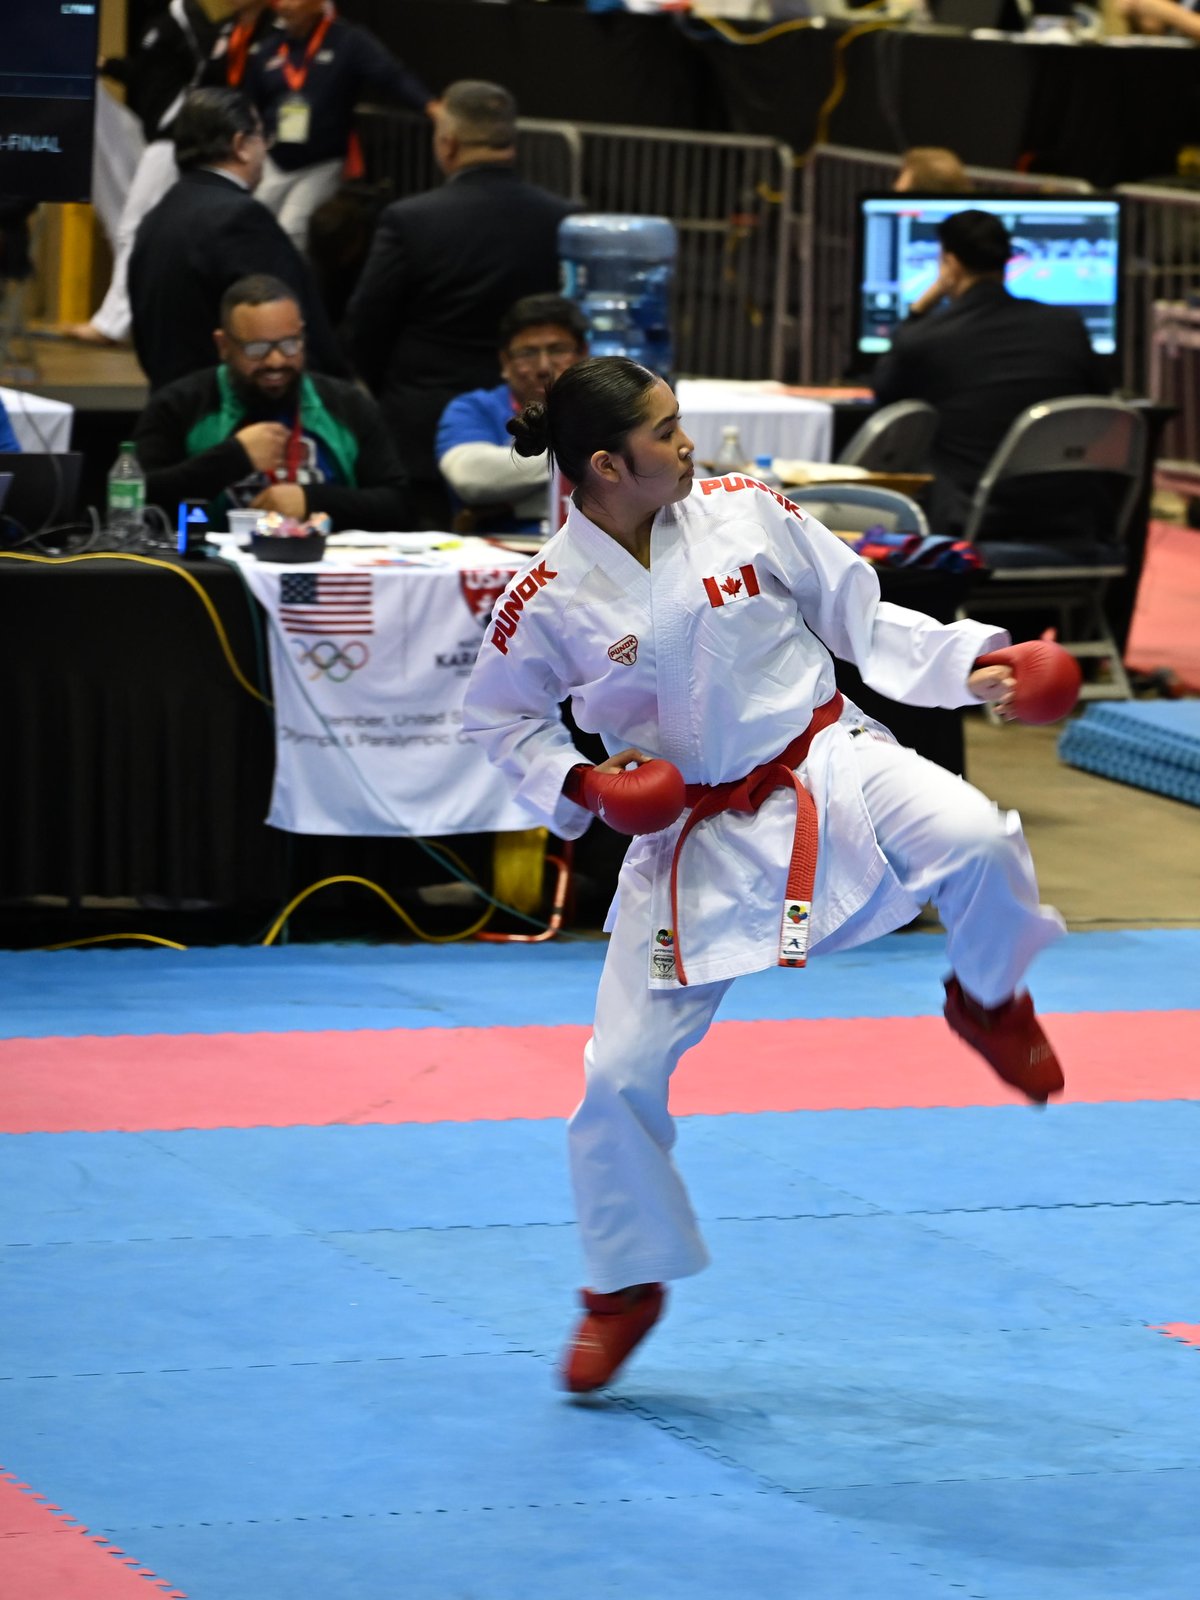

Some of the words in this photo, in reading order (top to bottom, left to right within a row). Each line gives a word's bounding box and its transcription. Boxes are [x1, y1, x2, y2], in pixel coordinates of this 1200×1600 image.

[490, 559, 558, 656] PUNOK
[610, 638, 636, 658] PUNOK
[325, 713, 387, 728] ember,
[393, 711, 446, 727] United
[359, 733, 449, 748] Paralympic
